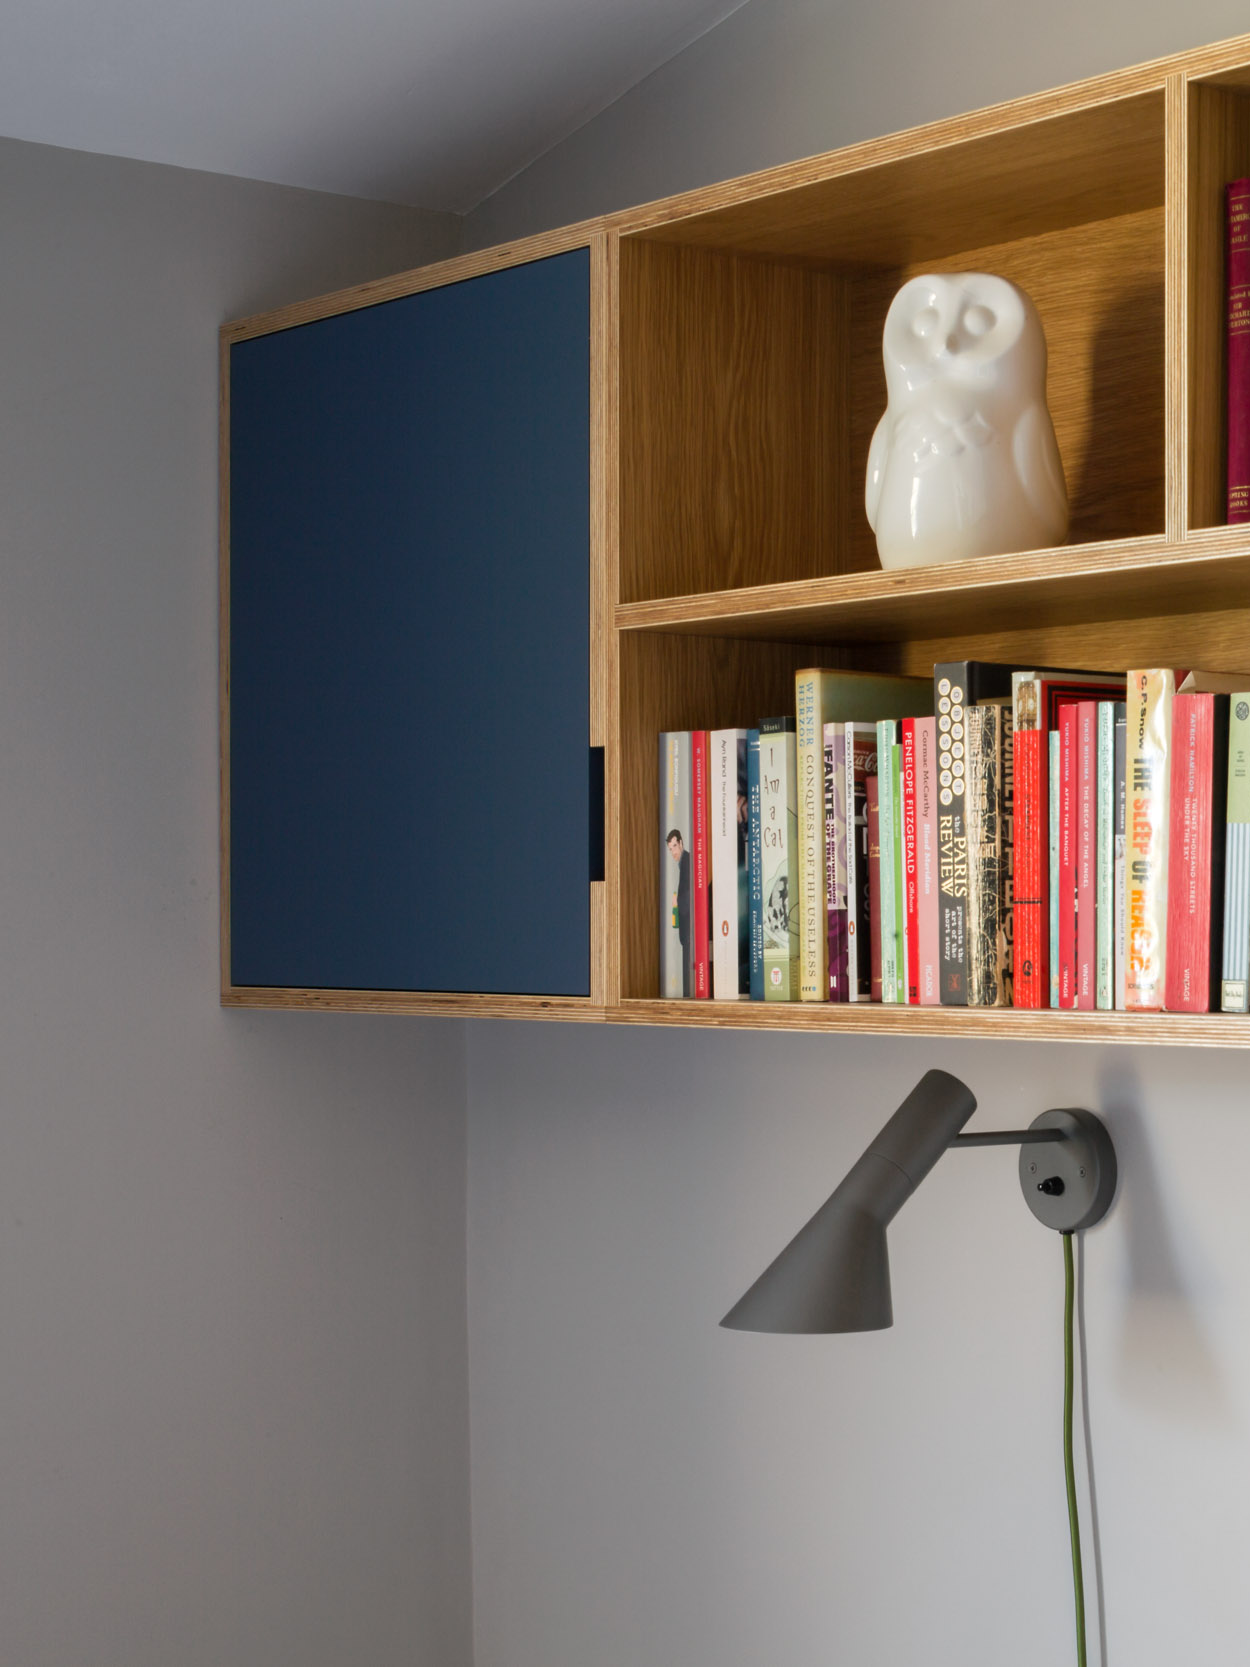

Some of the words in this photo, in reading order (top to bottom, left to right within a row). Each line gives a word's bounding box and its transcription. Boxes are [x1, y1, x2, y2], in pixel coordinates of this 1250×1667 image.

[798, 684, 806, 748] HERZOG
[806, 682, 814, 746] WERNER
[1138, 708, 1148, 750] Snow
[770, 747, 774, 768] I
[904, 732, 913, 794] PENELOPE
[1133, 758, 1152, 792] THE
[751, 785, 760, 814] THE
[764, 774, 780, 795] Am
[806, 754, 816, 841] CONQUEST
[824, 752, 835, 821] FANTE
[922, 770, 930, 818] McCarthy
[764, 826, 784, 849] Cat
[769, 806, 776, 821] a
[906, 800, 914, 874] FITZGERALD
[1132, 798, 1152, 855] SLEEP
[752, 818, 760, 900] ANTARCTIC
[807, 847, 816, 868] OF
[940, 815, 954, 898] REVIEW
[954, 836, 968, 898] PARIS
[1131, 860, 1152, 884] OF
[808, 870, 816, 900] THE
[808, 906, 816, 978] USELESS
